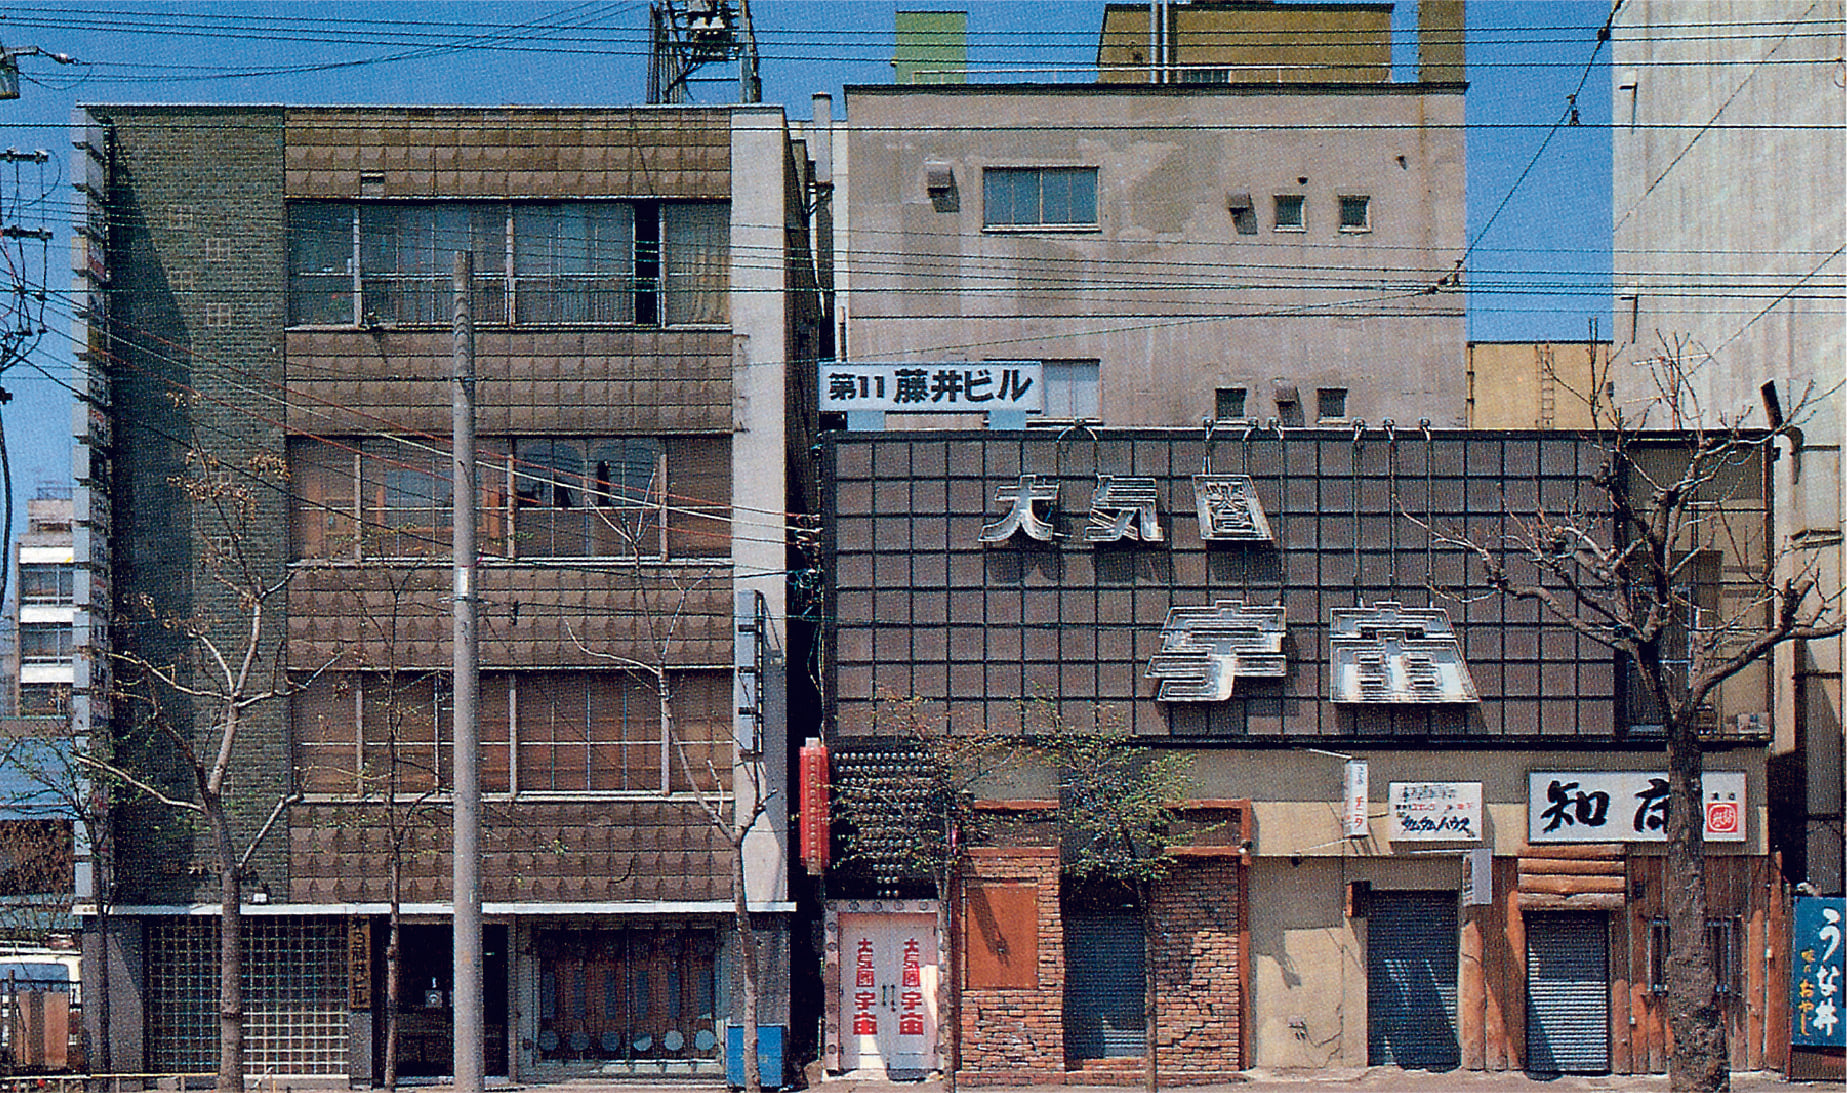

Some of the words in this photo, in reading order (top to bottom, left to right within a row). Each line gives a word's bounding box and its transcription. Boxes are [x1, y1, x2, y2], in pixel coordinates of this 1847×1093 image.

[828, 368, 1034, 403] 第11藤井ビル
[978, 474, 1274, 542] 大気圏
[1144, 600, 1482, 703] 宇宙
